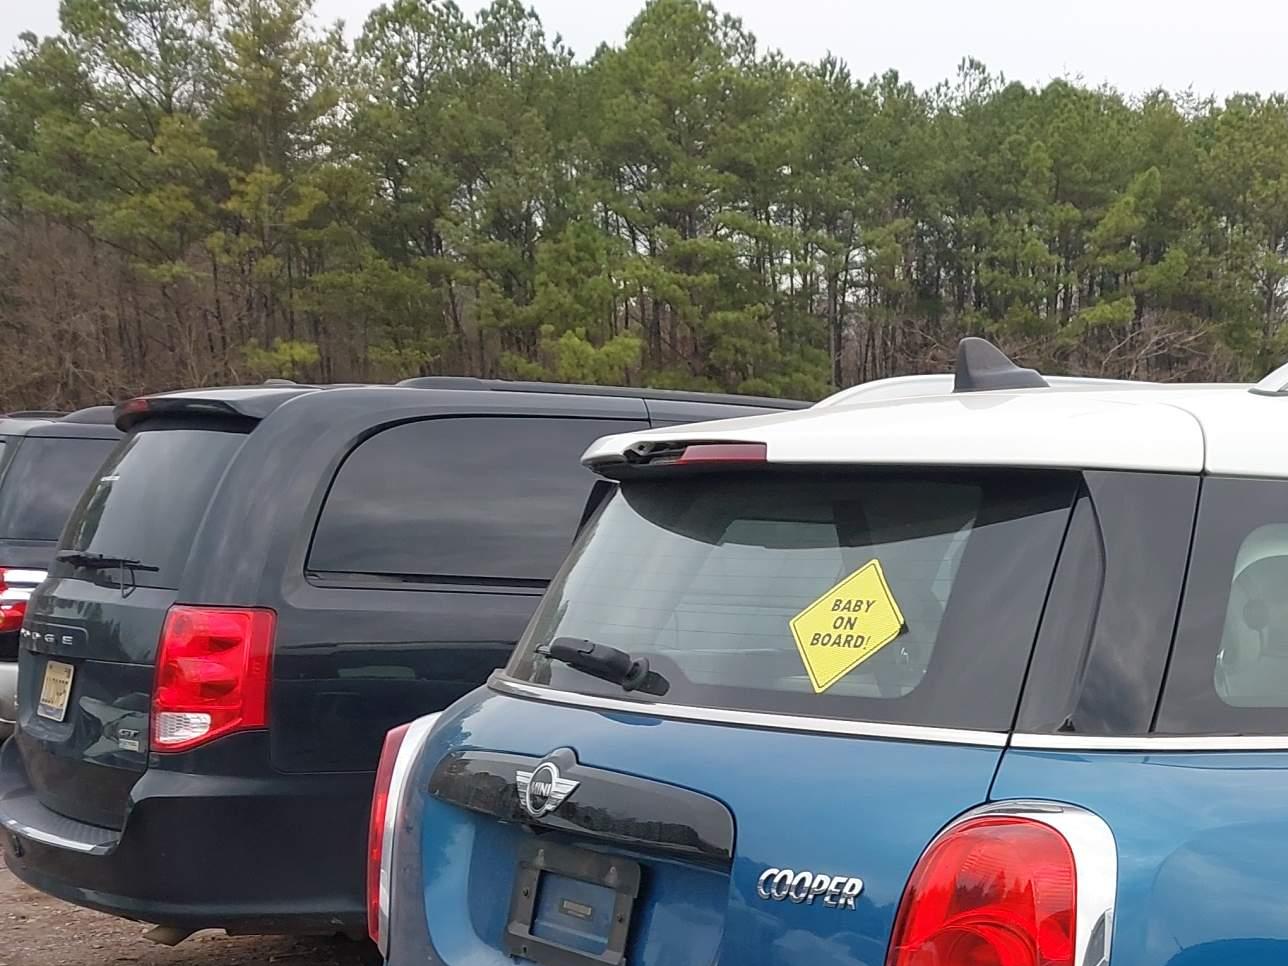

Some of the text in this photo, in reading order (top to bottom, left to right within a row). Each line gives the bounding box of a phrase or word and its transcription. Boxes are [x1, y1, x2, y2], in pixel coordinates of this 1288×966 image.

[831, 599, 876, 613] BABY
[832, 616, 857, 630] ON
[810, 632, 871, 650] BOARD!
[531, 781, 552, 797] MINI
[757, 867, 863, 910] COOPER
